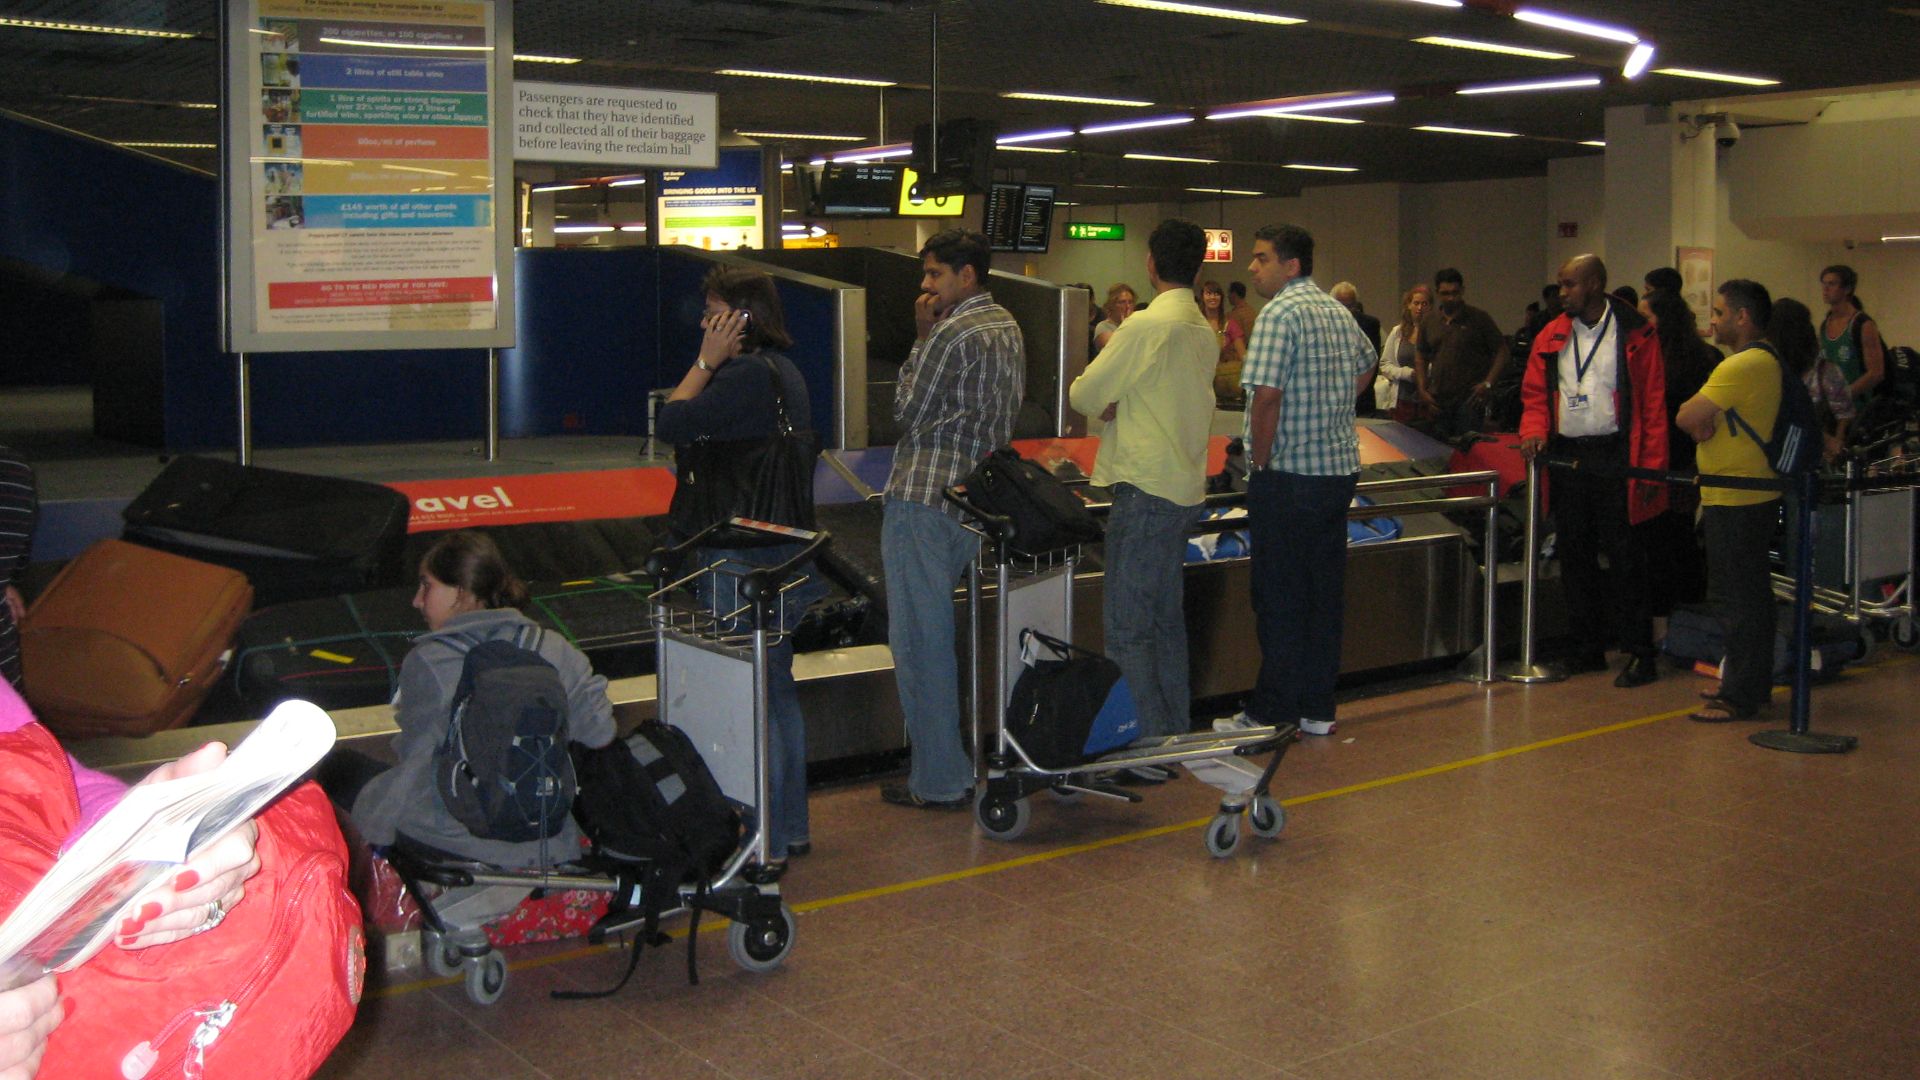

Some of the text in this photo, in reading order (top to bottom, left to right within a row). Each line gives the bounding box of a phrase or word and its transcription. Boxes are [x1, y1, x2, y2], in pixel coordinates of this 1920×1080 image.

[346, 67, 352, 76] 2
[377, 68, 386, 76] of
[519, 90, 678, 110] Passengers are requested to
[519, 106, 694, 126] check that they have identified
[519, 122, 706, 144] and collected all of their baggage
[519, 136, 691, 156] before leaving the reclaim hall
